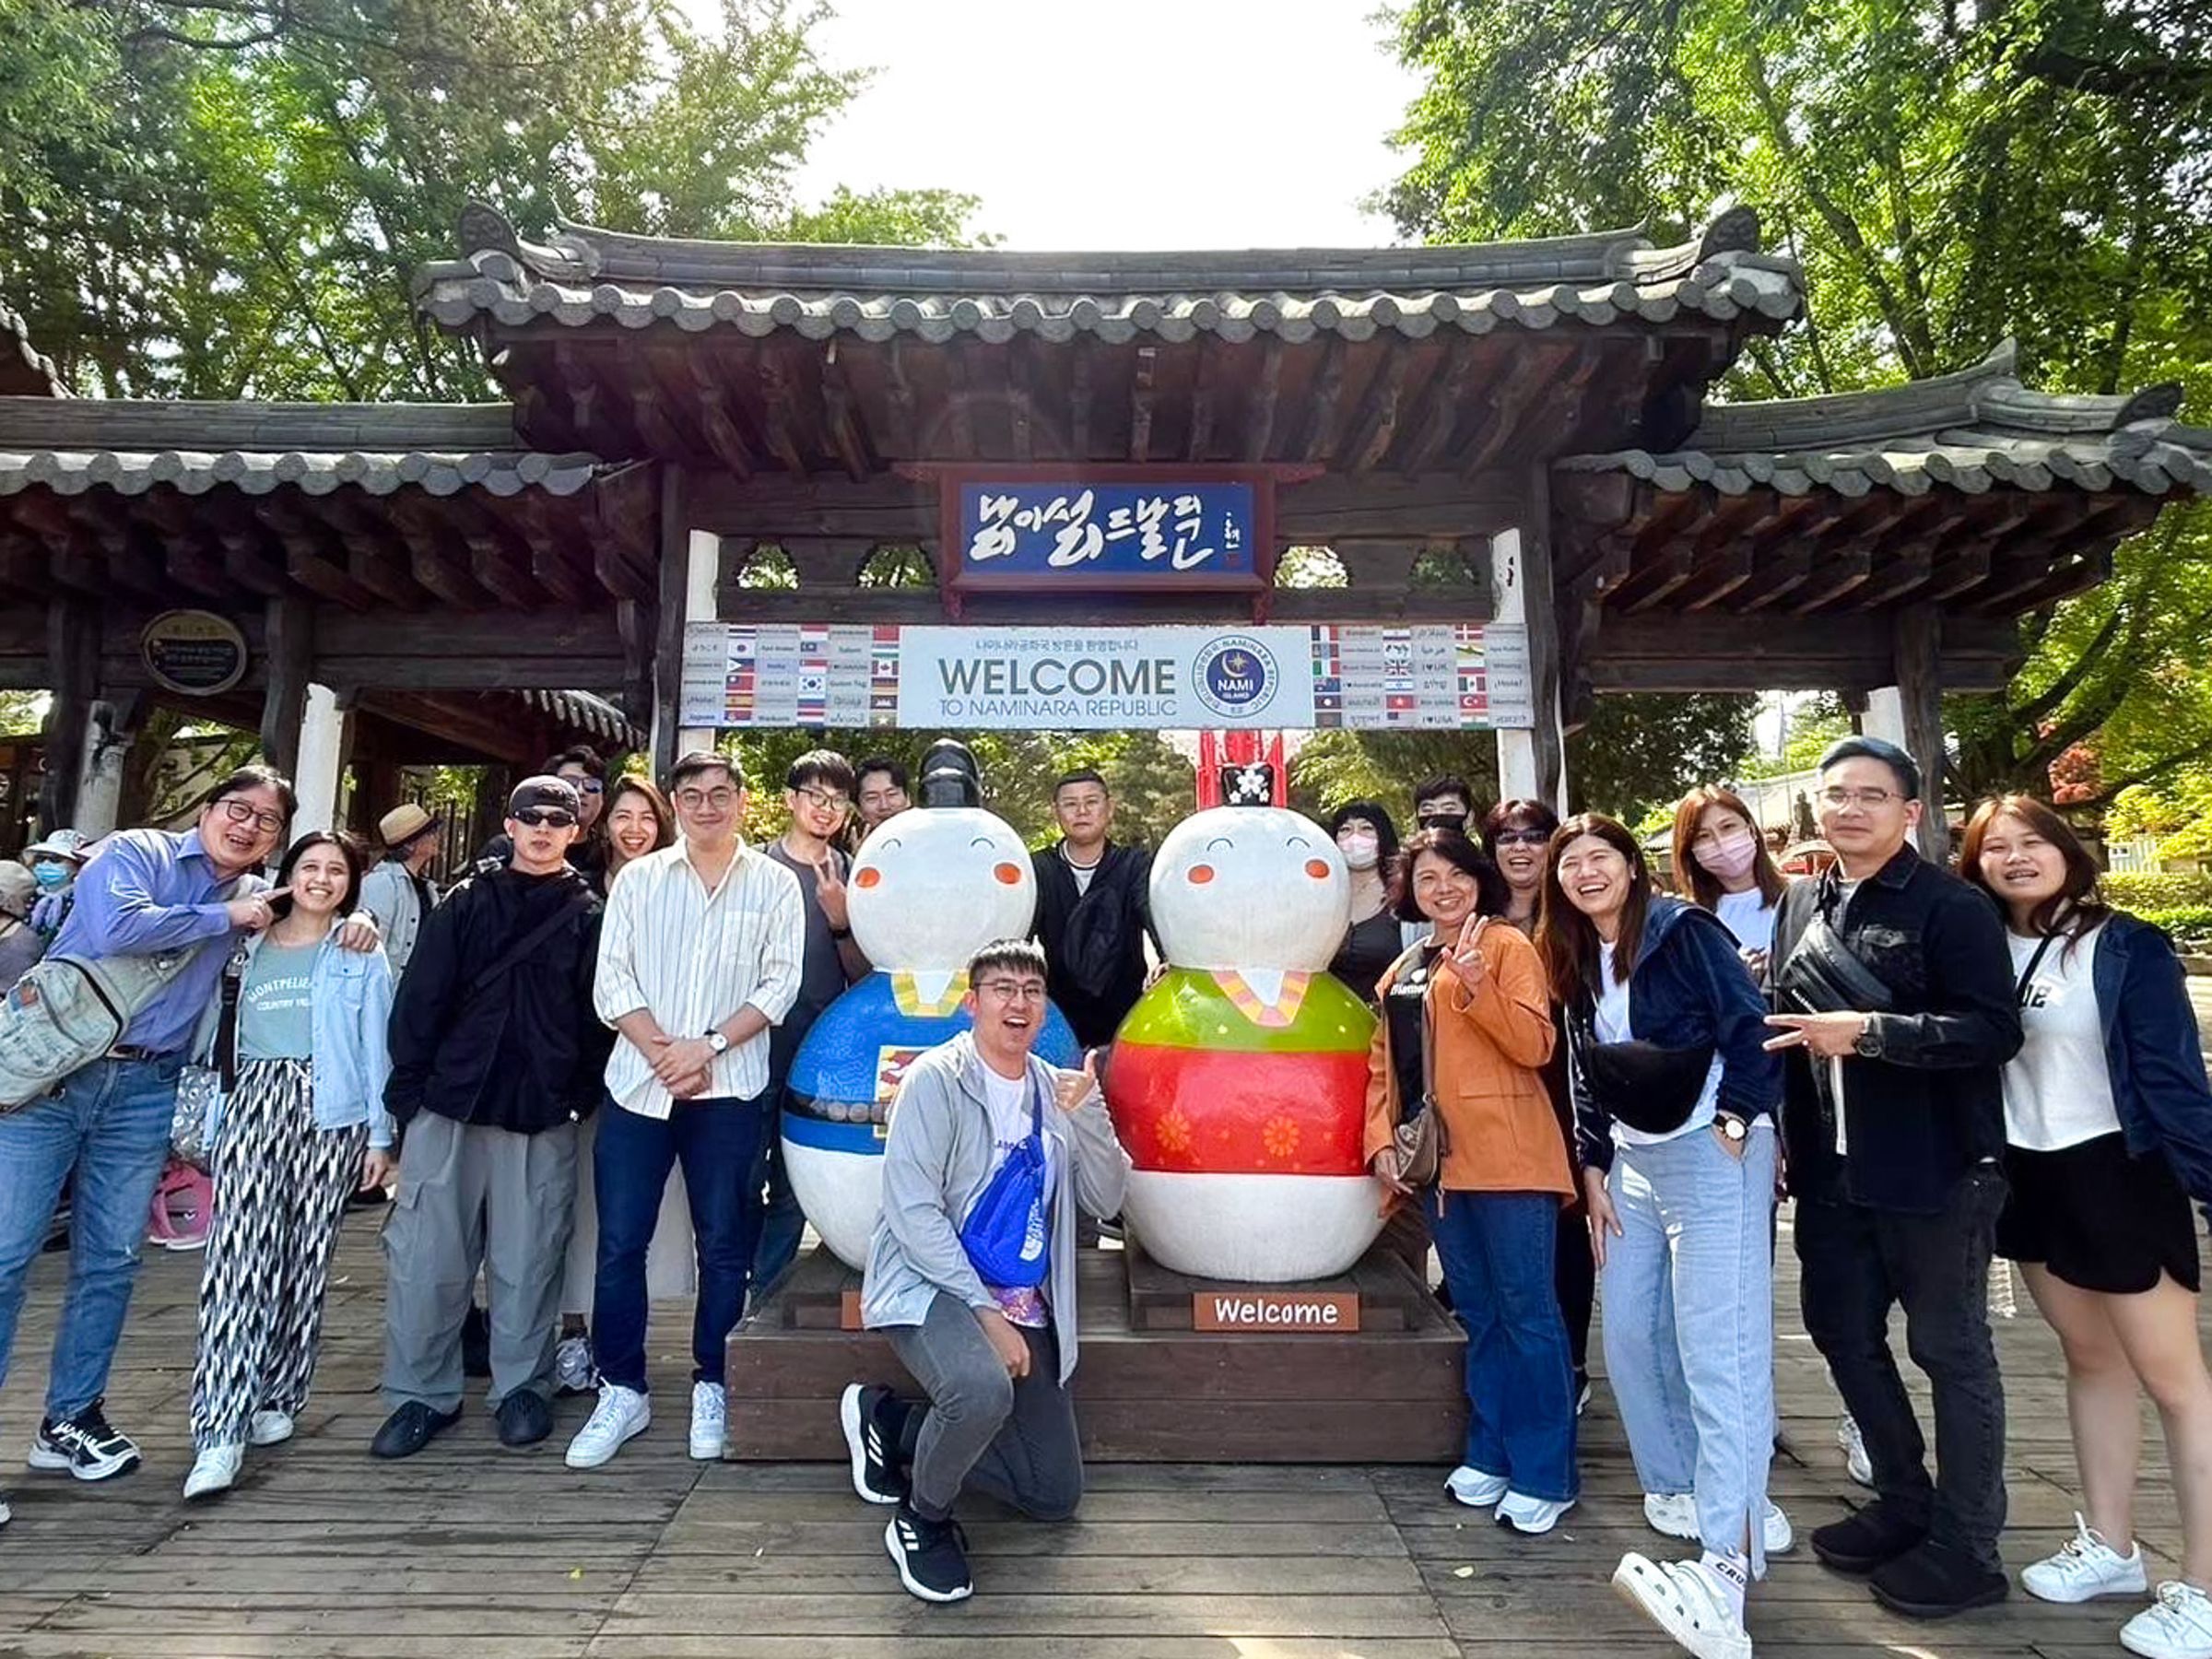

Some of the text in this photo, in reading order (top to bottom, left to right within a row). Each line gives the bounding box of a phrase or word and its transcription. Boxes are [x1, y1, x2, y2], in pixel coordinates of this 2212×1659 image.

[937, 658, 1176, 696] WELCOME
[1217, 678, 1254, 691] NAMI
[939, 698, 1177, 717] TO NAMINARA REPUBLIC
[1215, 1298, 1338, 1324] Welcome
